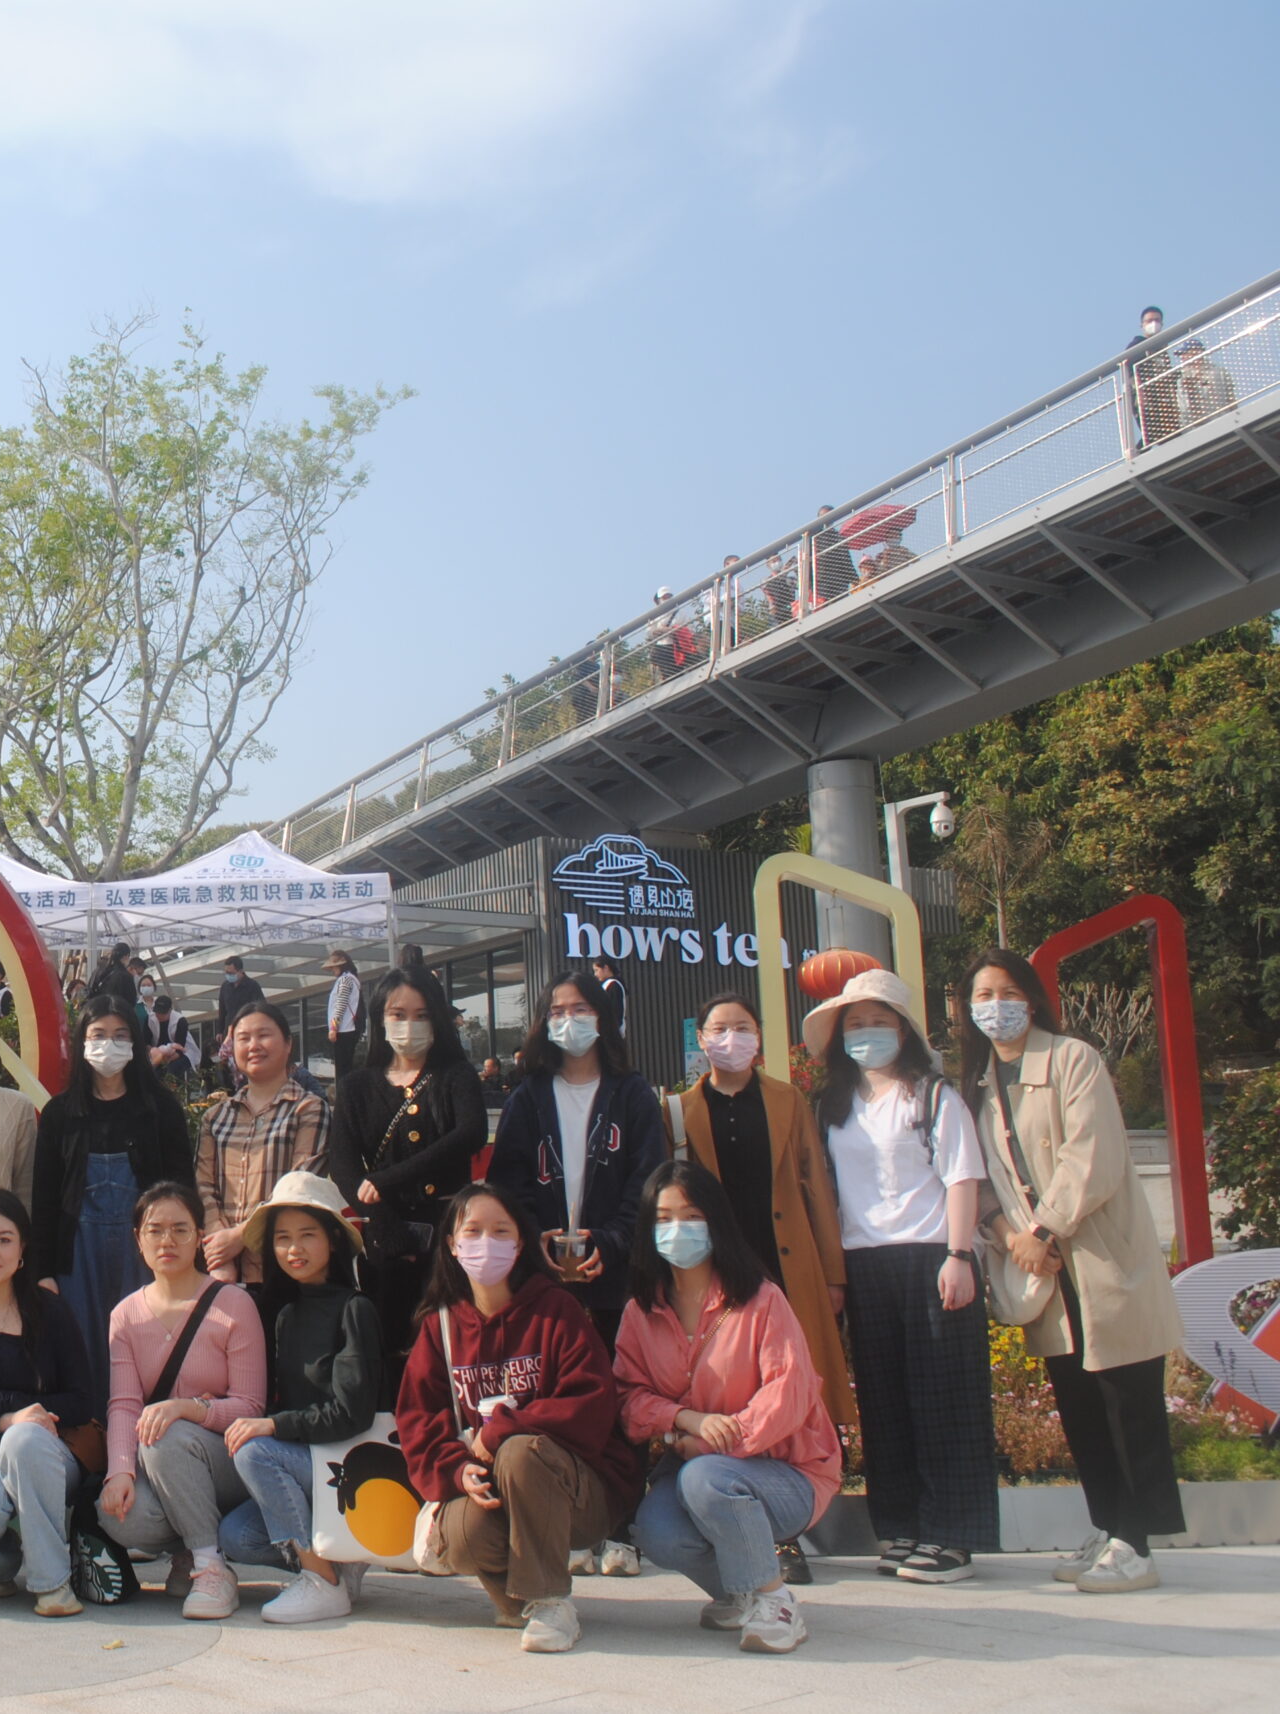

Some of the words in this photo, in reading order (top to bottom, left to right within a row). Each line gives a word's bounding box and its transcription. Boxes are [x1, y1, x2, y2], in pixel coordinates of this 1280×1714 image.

[106, 880, 373, 907] 弘爱医院急救知识普及活动
[628, 907, 639, 915] YU
[641, 908, 658, 916] JIAN
[659, 909, 680, 917] SHAN
[453, 1356, 542, 1399] SHIPESUR
